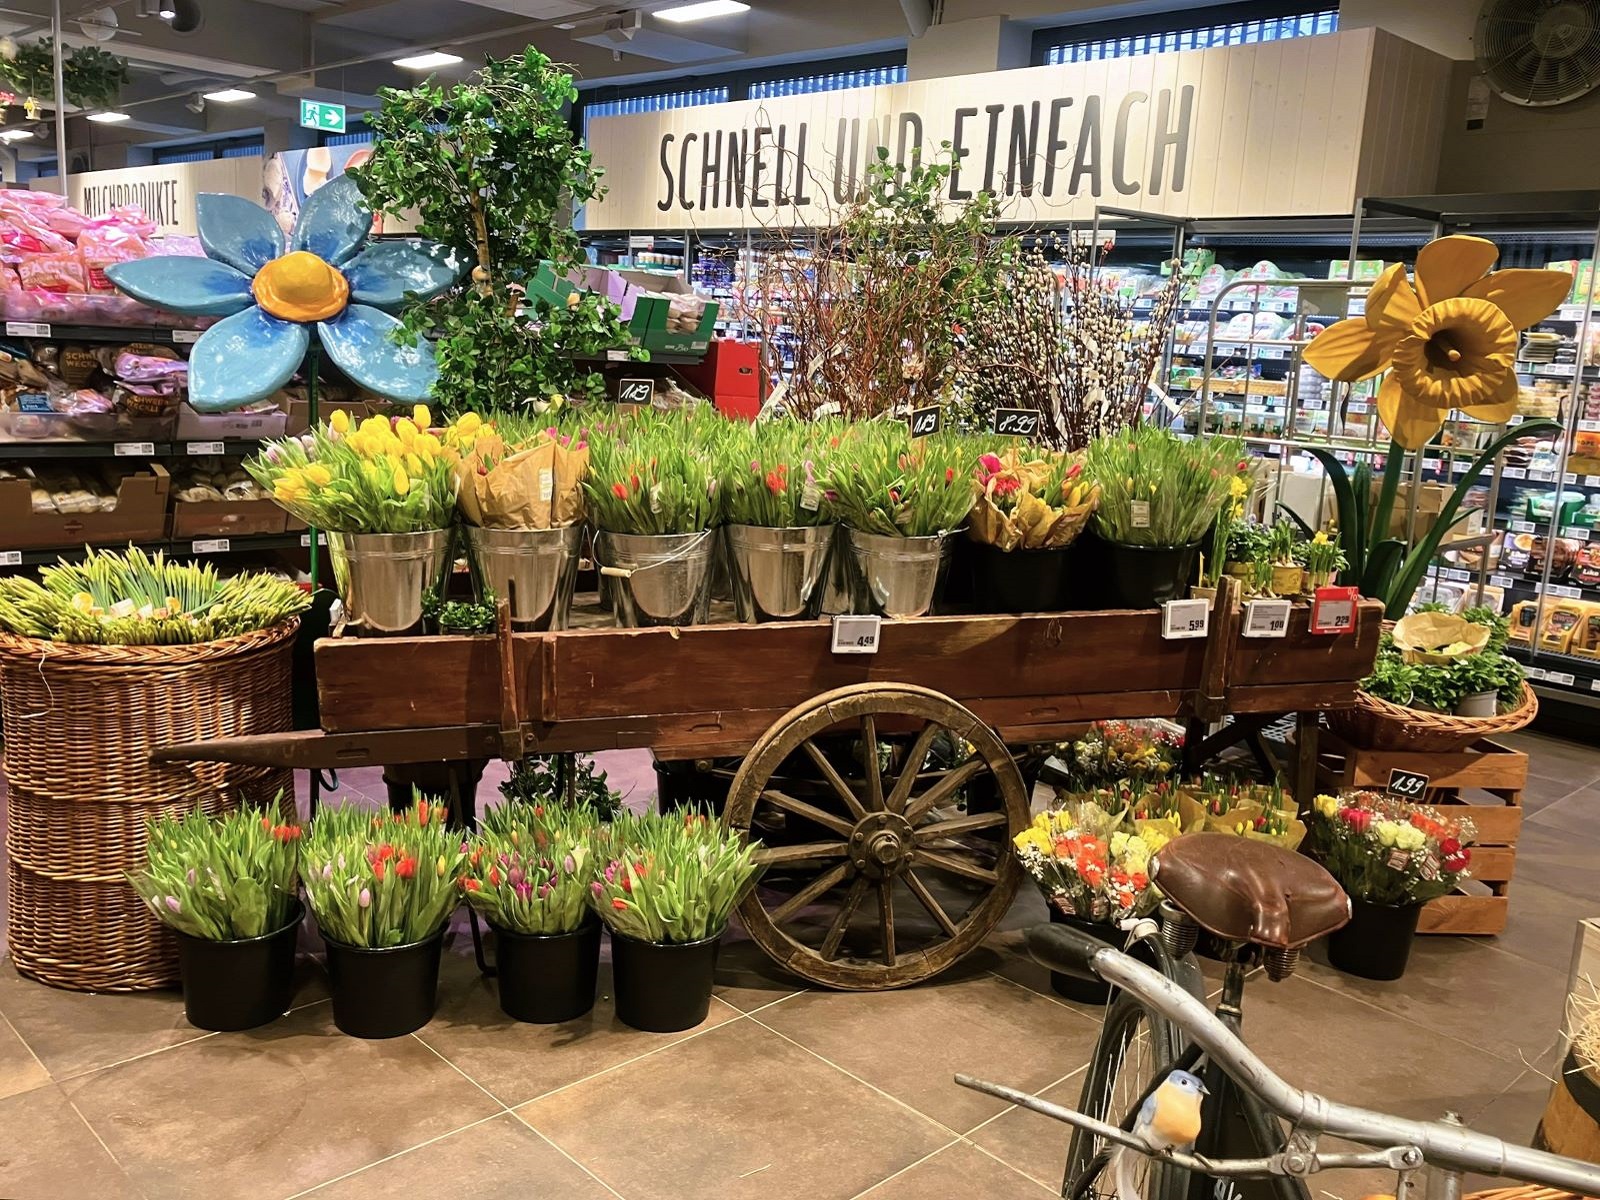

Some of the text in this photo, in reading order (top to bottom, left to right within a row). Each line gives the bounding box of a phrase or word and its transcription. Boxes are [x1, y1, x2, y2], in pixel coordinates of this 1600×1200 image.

[657, 84, 1195, 212] SCHNELL UND EINFACH
[1189, 619, 1205, 631] 5.99
[856, 635, 875, 647] 4.49
